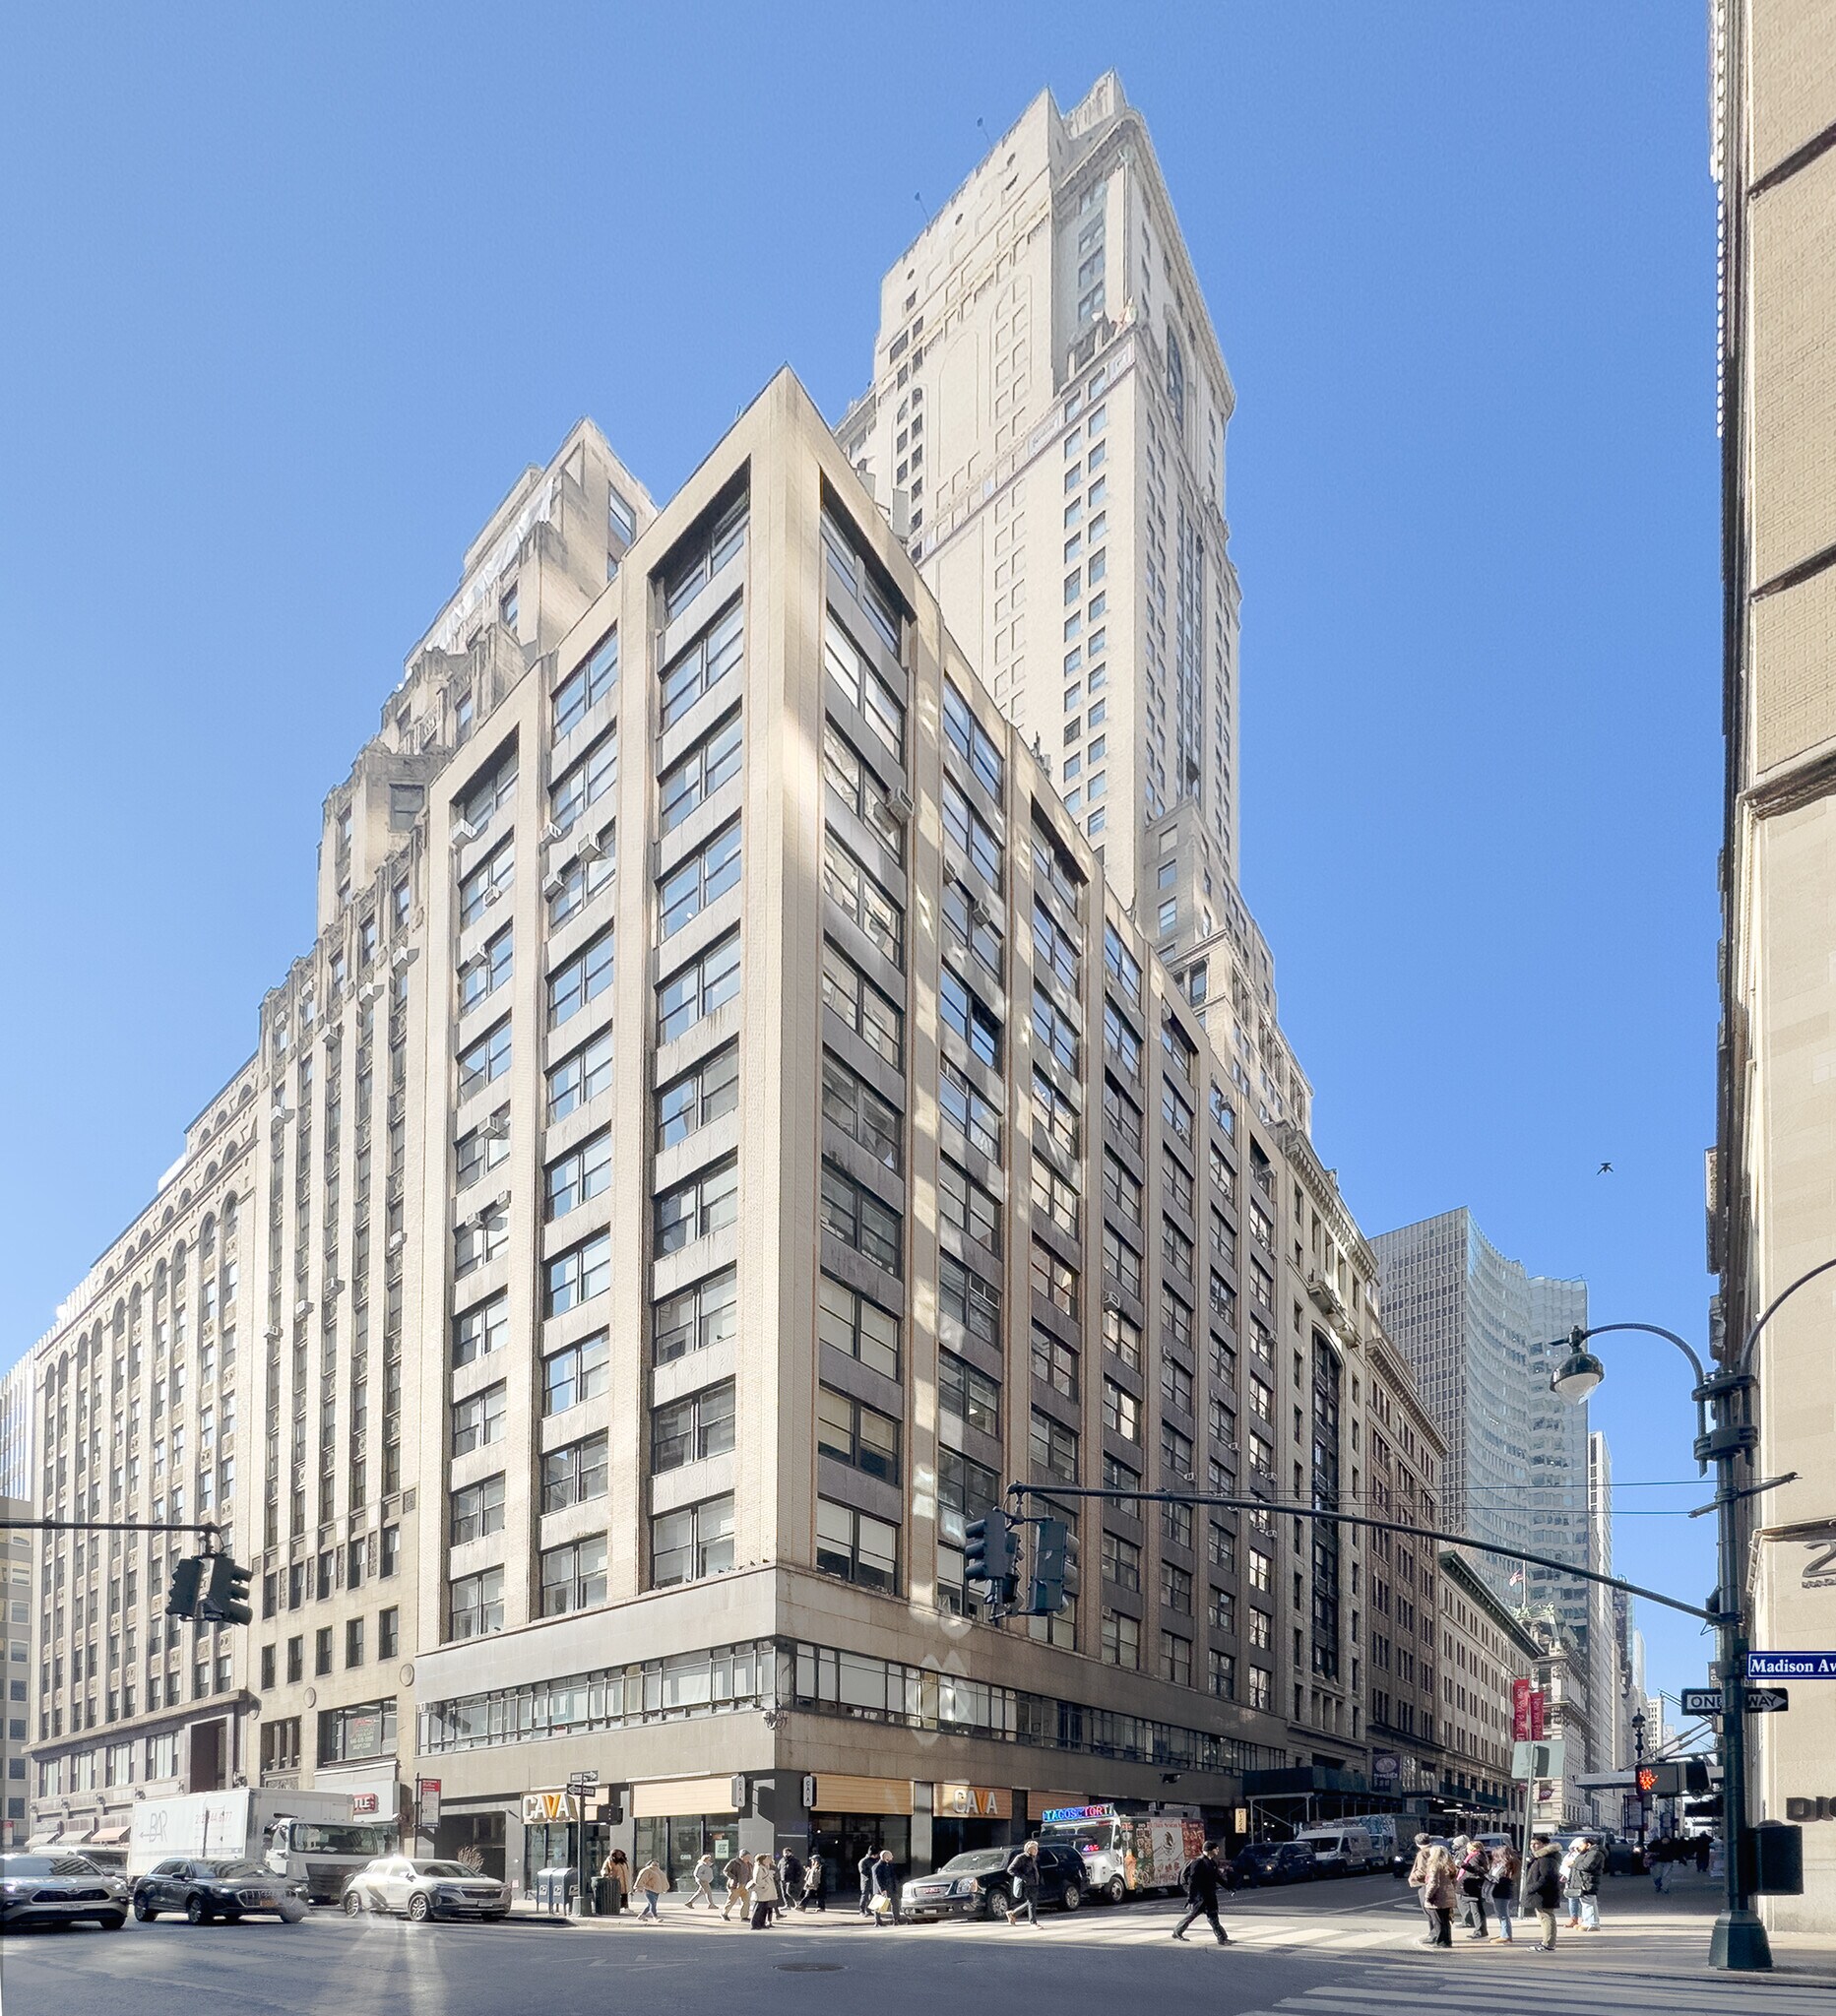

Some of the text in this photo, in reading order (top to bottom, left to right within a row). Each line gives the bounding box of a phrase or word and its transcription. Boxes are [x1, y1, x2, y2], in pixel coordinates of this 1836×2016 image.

[1750, 1659, 1814, 1673] Madison
[1748, 1695, 1776, 1707] WAY
[523, 1794, 570, 1818] CAVA
[953, 1789, 997, 1814] CAVA
[1786, 1796, 1836, 1822] DI
[1045, 1808, 1077, 1819] TACOS
